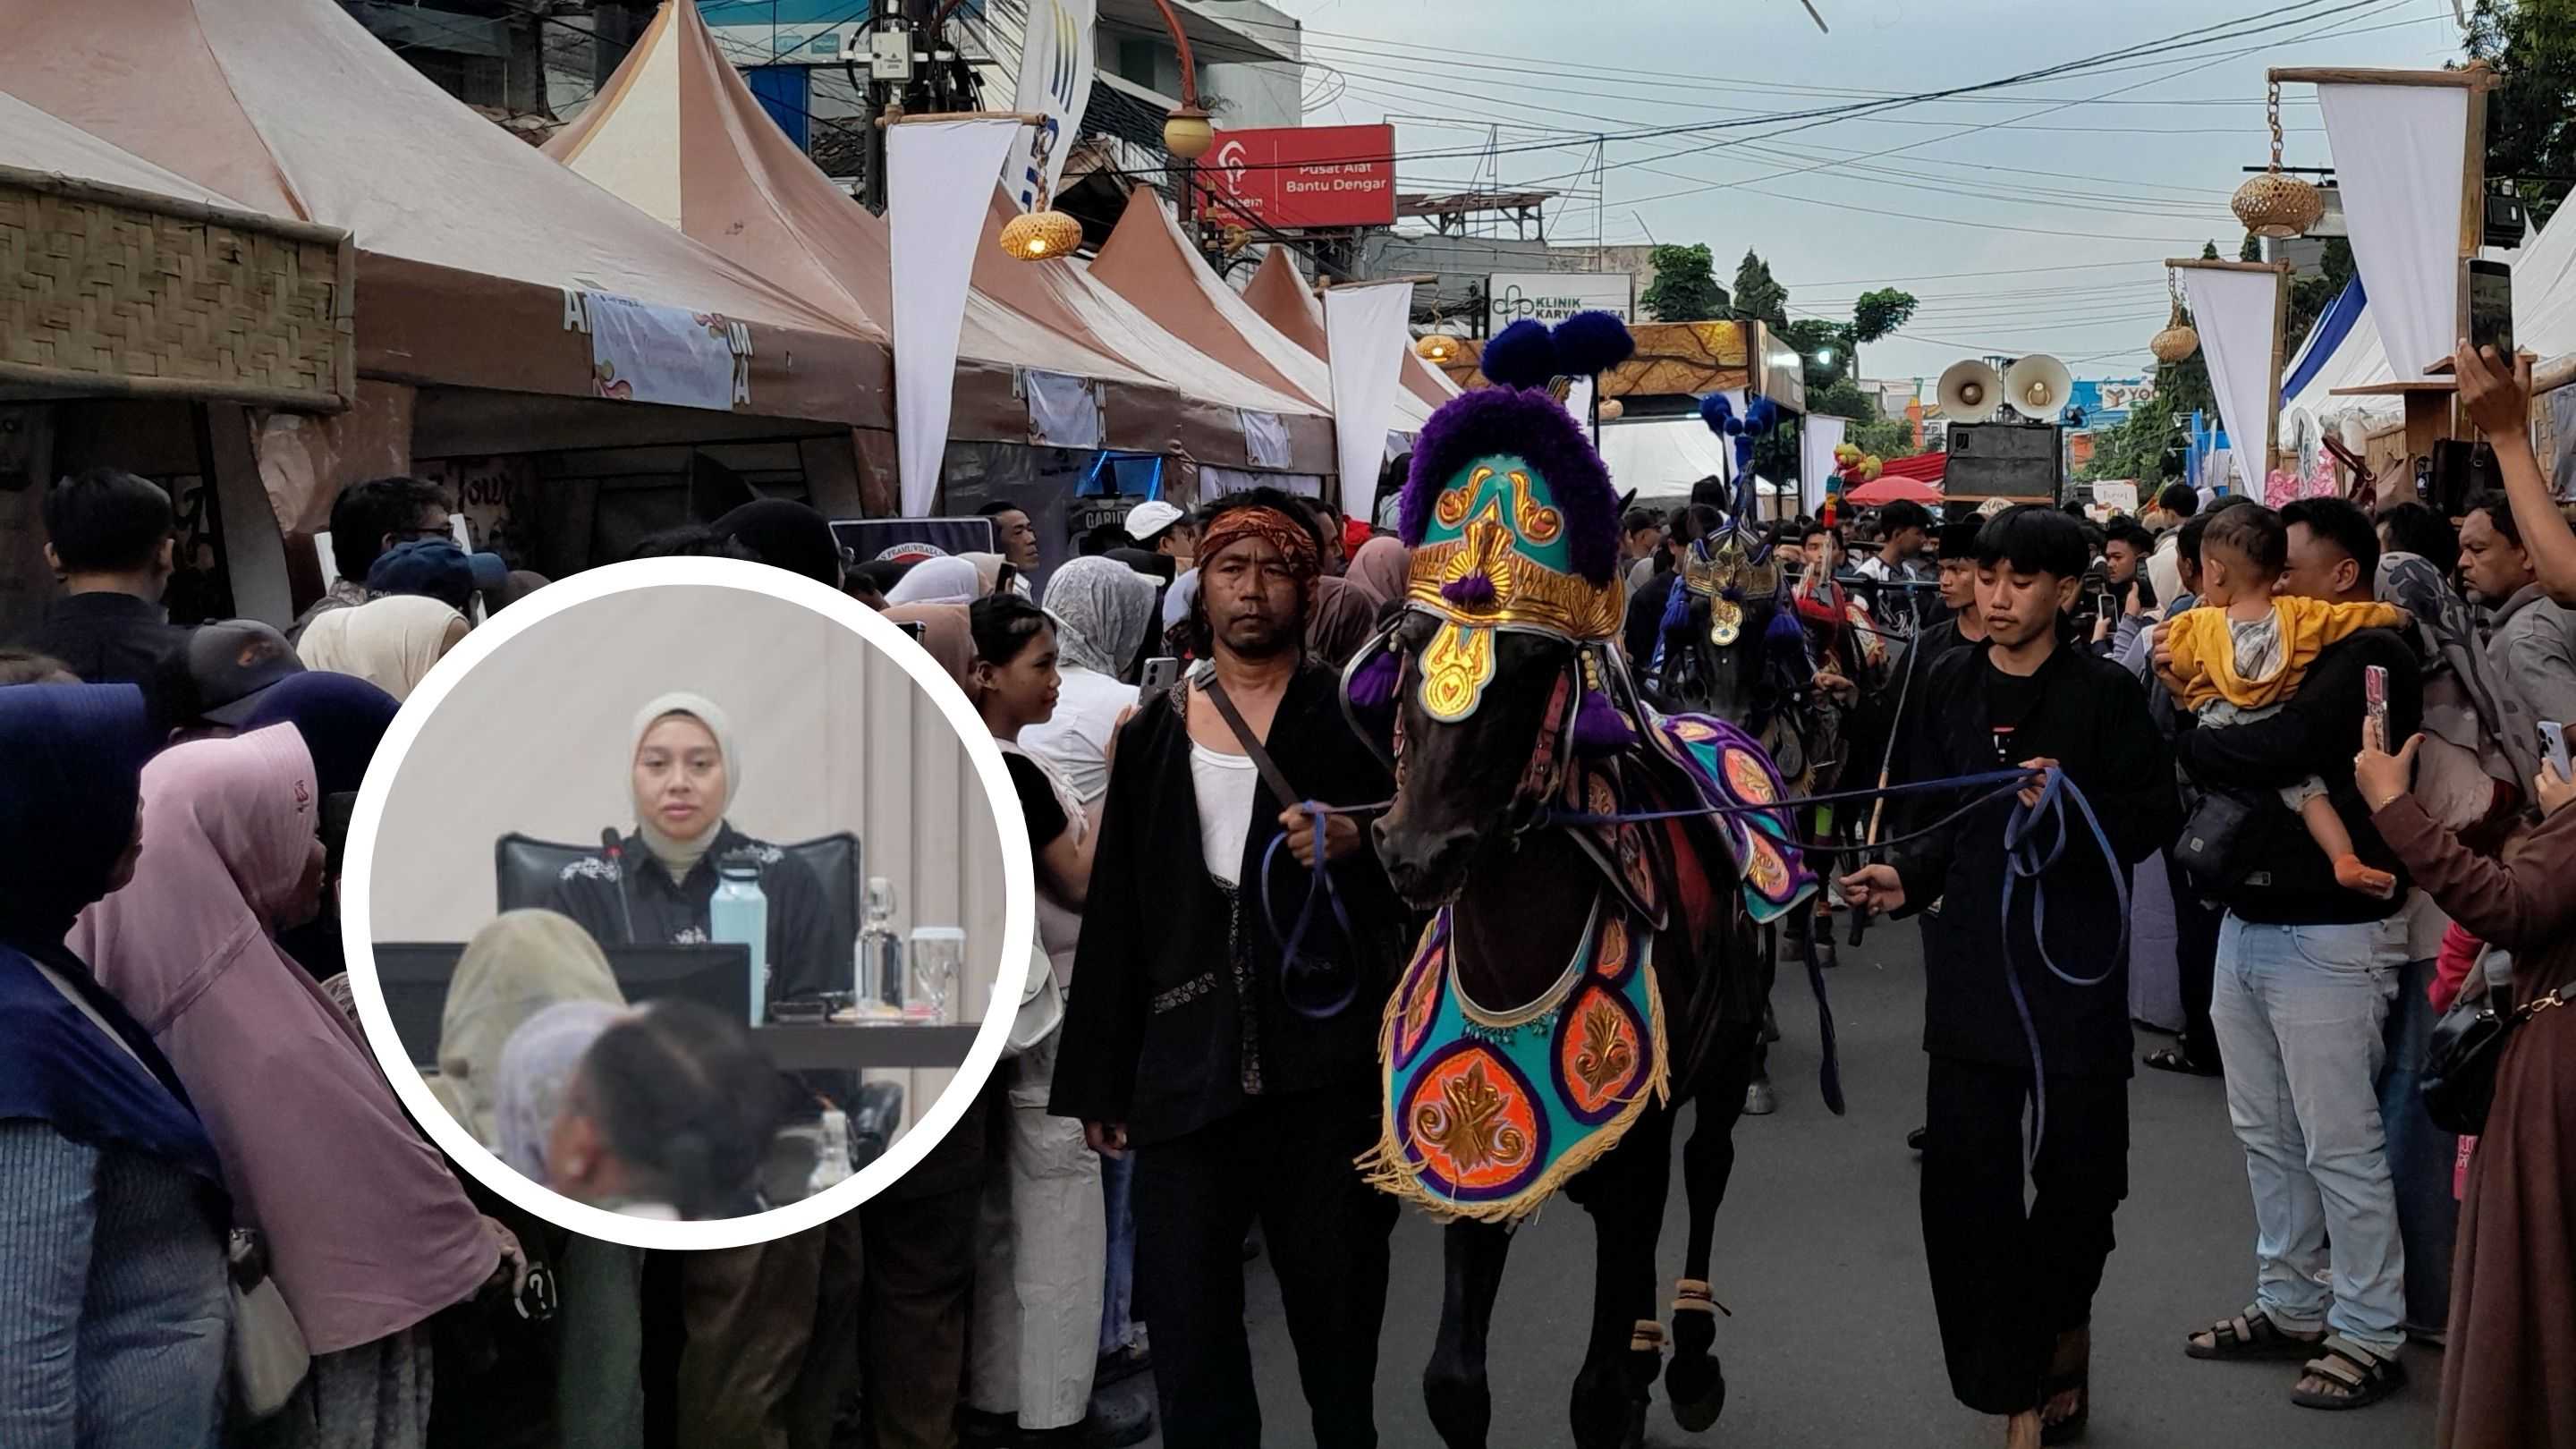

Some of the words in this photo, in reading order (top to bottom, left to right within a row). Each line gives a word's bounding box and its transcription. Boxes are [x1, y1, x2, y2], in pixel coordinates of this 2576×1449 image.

[1300, 164, 1340, 175] Pusat
[1286, 181, 1329, 192] Bantu
[1333, 179, 1386, 192] Dengar
[1536, 297, 1581, 309] KLINIK
[1536, 309, 1577, 319] KARYA
